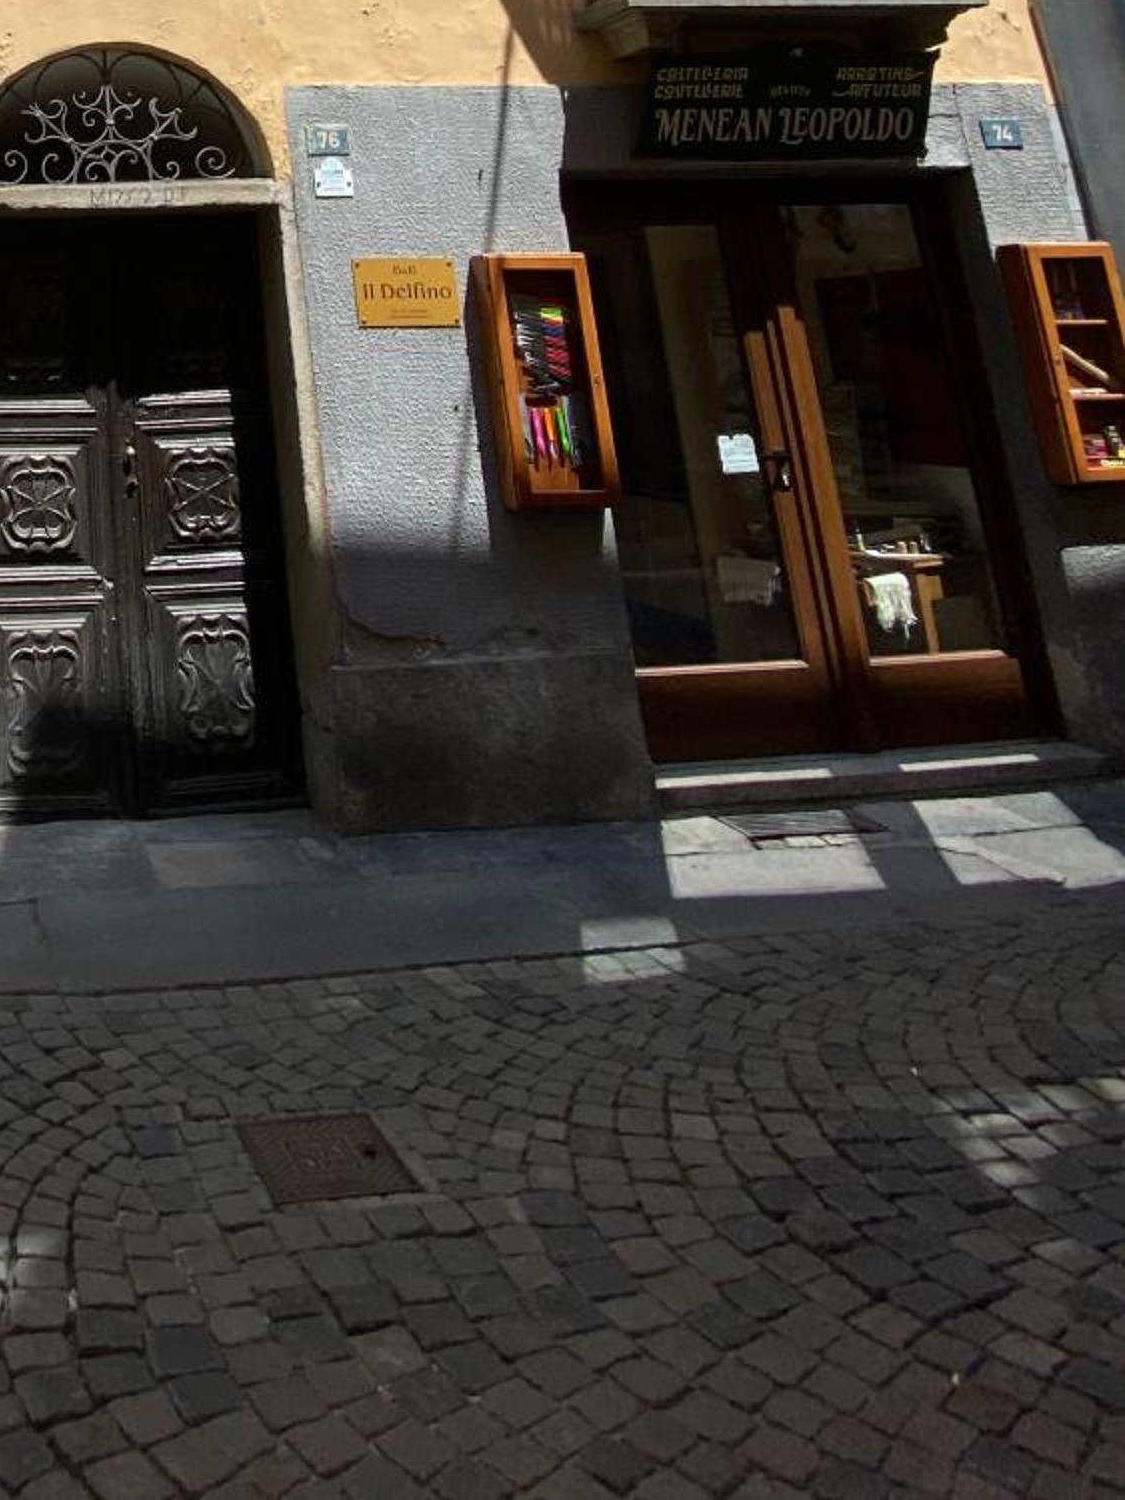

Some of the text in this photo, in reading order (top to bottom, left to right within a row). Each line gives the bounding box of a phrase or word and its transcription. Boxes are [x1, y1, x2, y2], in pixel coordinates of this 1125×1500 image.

[654, 107, 914, 146] MENEAN LEOPOLDO
[991, 124, 1013, 142] 74
[316, 130, 341, 149] 76
[380, 281, 453, 300] Delfino
